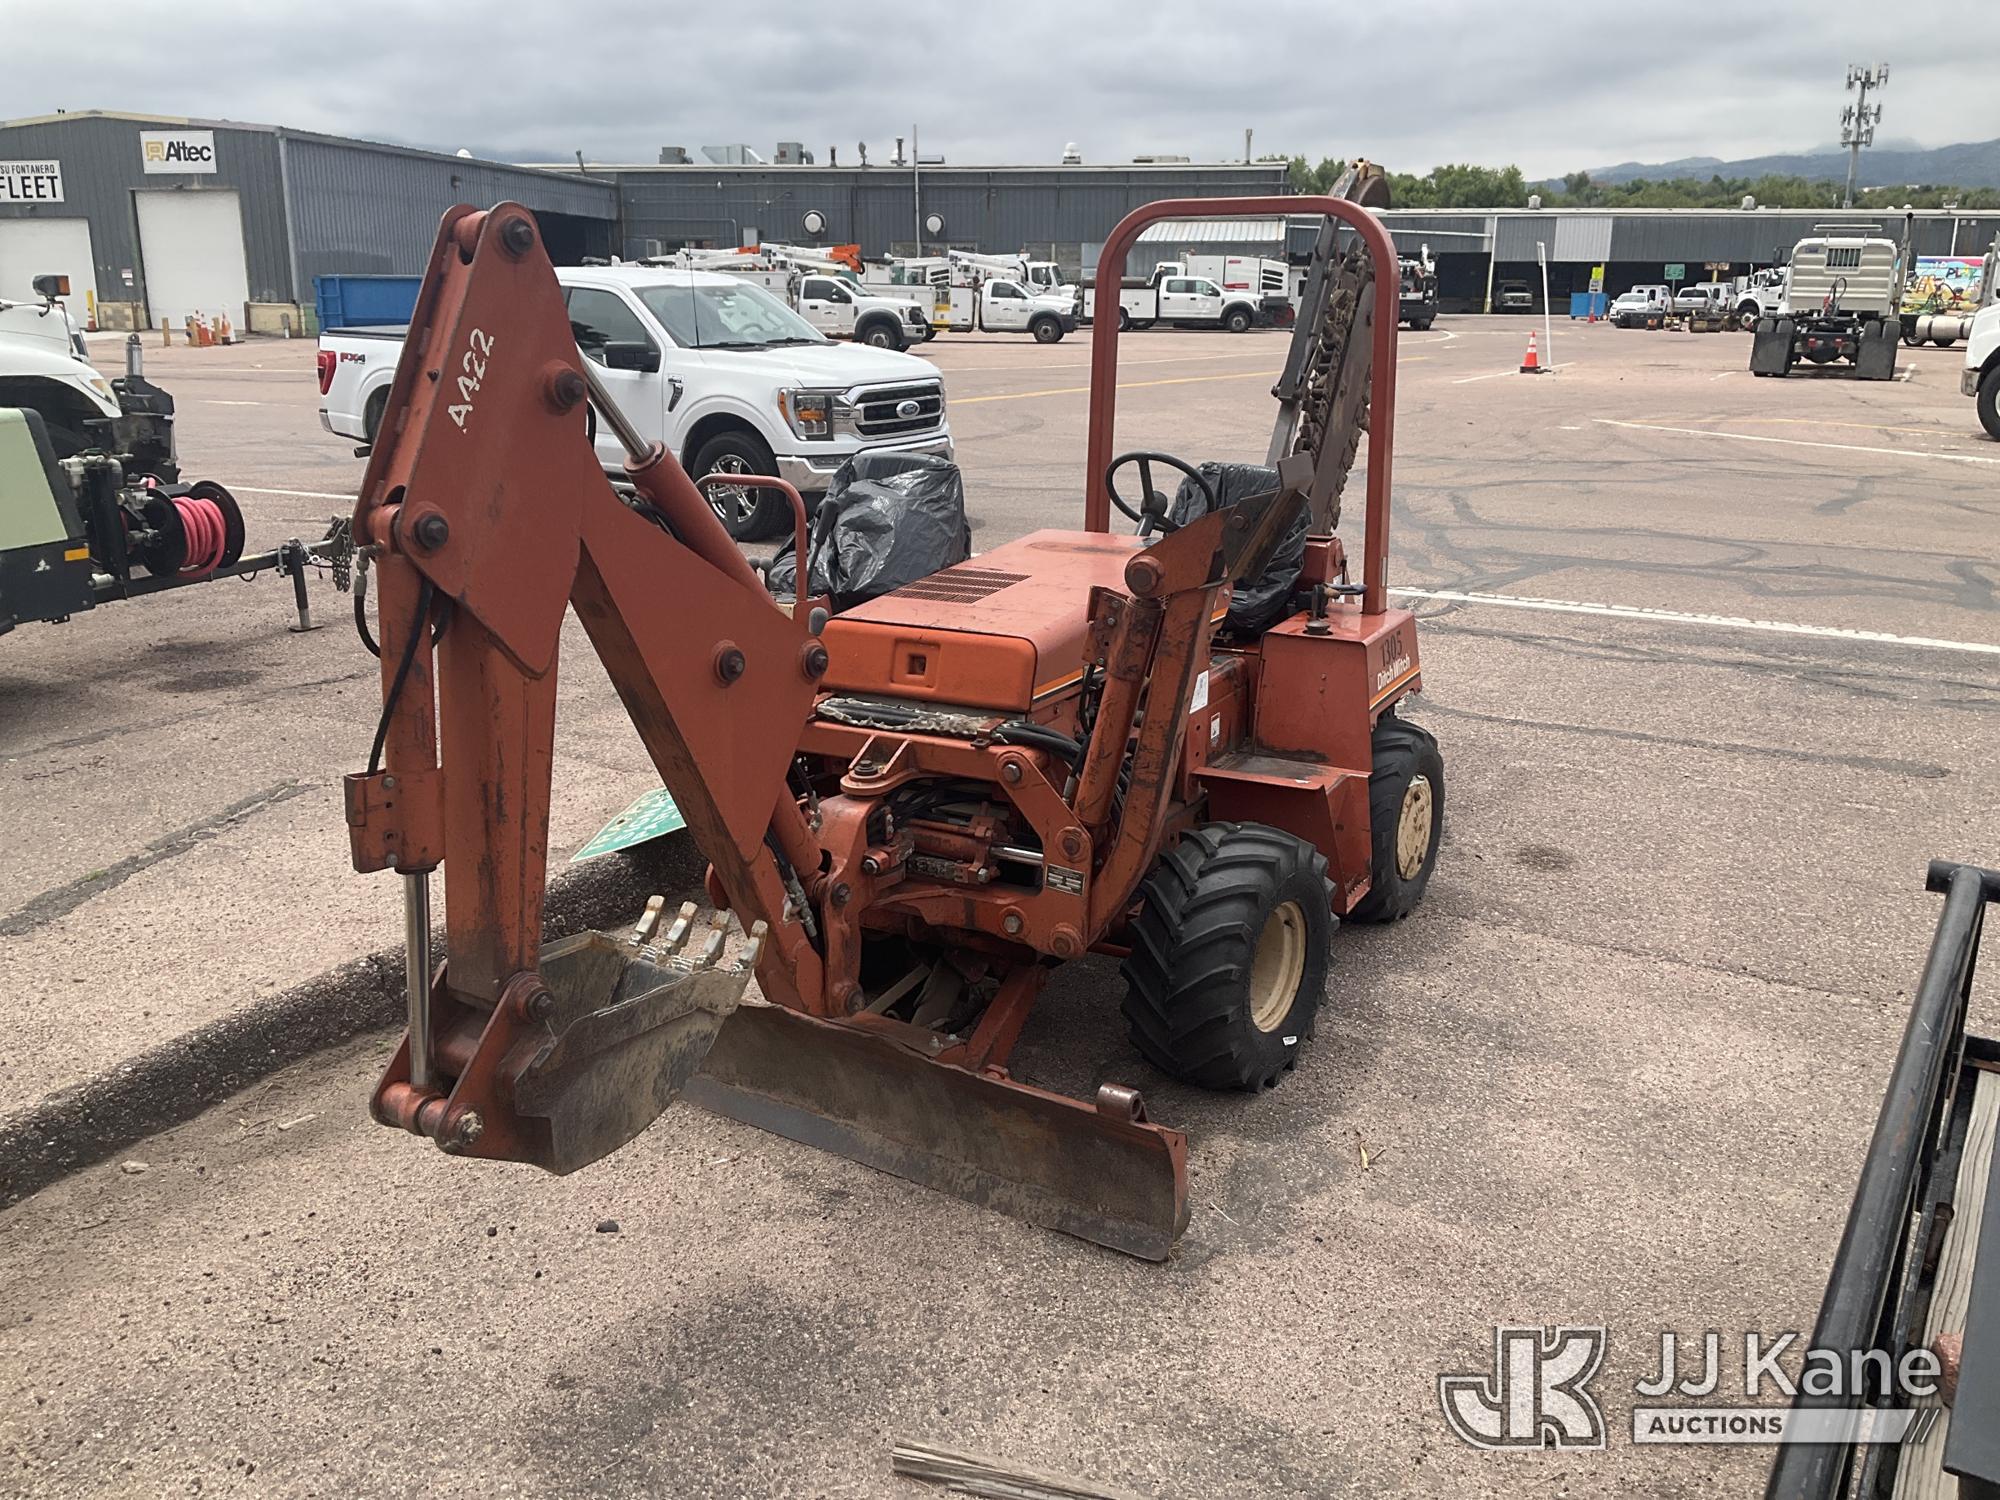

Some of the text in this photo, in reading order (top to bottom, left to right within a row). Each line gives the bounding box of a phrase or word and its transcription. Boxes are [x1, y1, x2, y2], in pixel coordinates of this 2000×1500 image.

[166, 141, 212, 161] Altec
[0, 165, 10, 174] SU
[340, 352, 366, 363] FX4
